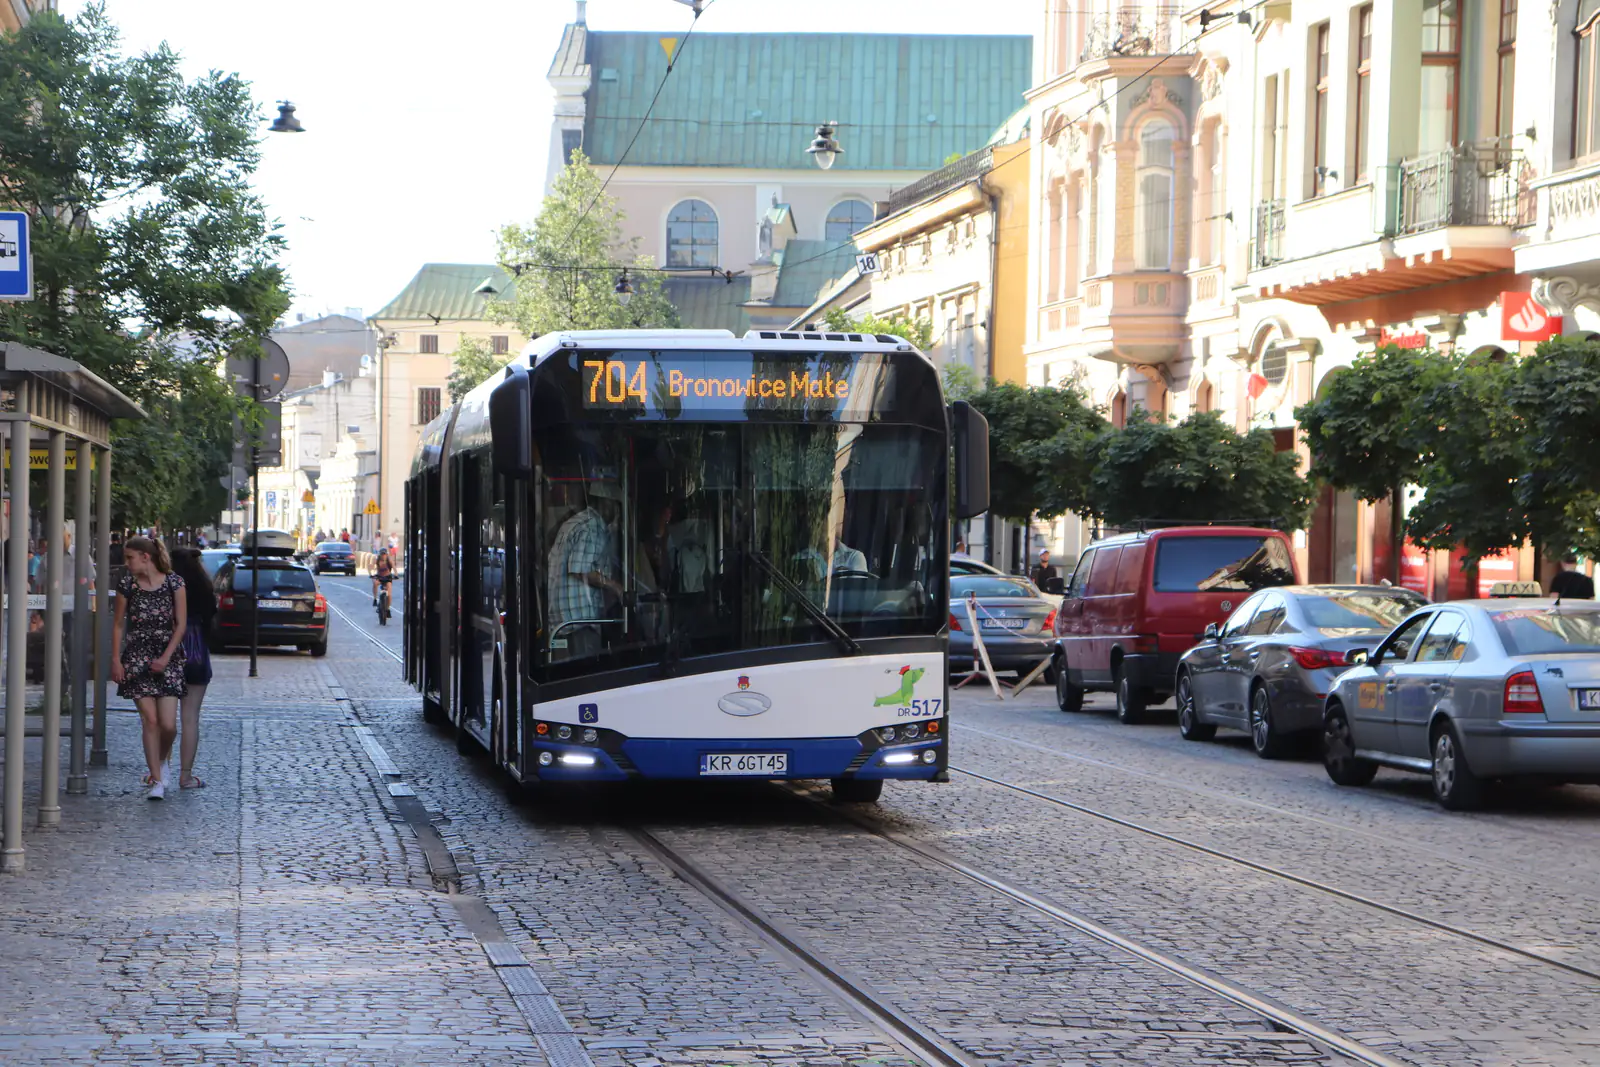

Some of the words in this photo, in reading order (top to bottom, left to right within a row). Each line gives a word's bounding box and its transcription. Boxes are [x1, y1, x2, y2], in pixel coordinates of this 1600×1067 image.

[584, 361, 647, 402] 704
[669, 369, 786, 398] Bronowice
[791, 370, 849, 398] Małe
[1501, 583, 1535, 594] TAXI
[709, 755, 731, 770] KR
[737, 755, 784, 770] 6GT45
